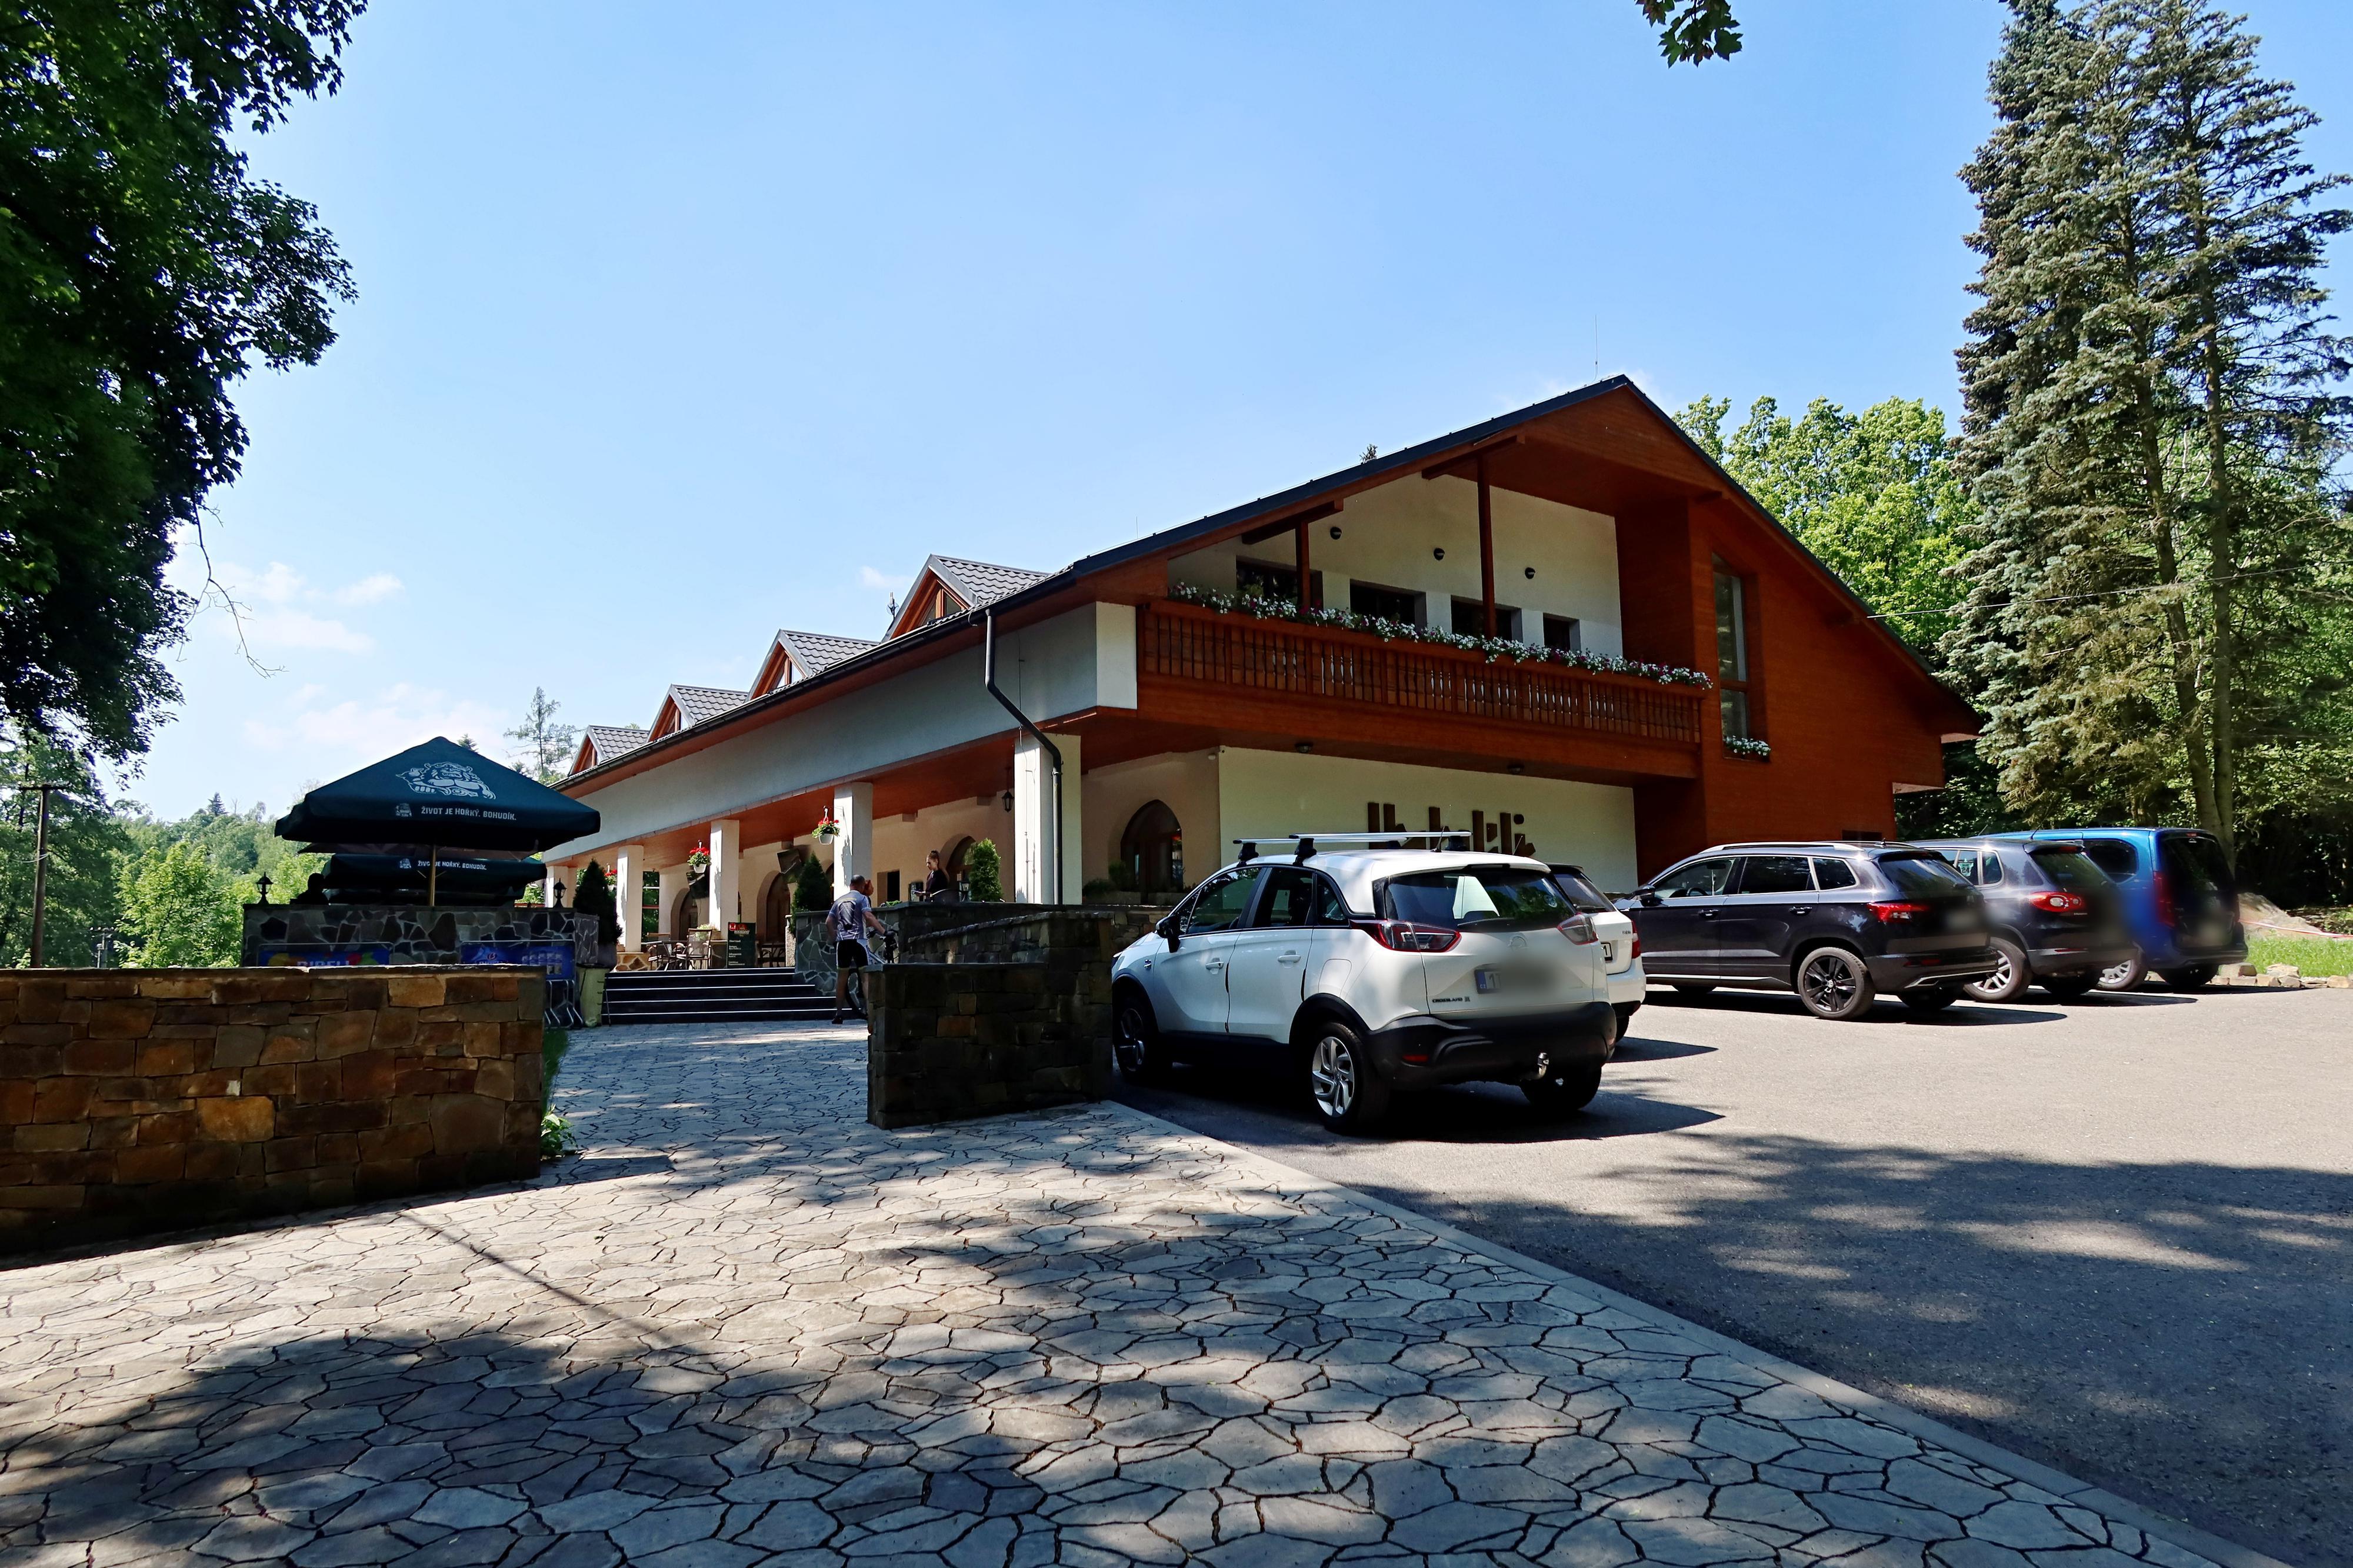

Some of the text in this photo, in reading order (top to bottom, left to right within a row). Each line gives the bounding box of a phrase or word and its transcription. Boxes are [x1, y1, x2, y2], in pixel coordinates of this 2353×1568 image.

[421, 806, 442, 815] ŽIVOT
[455, 808, 481, 818] HOŘKÝ.
[483, 810, 516, 820] BOHUDÍK.
